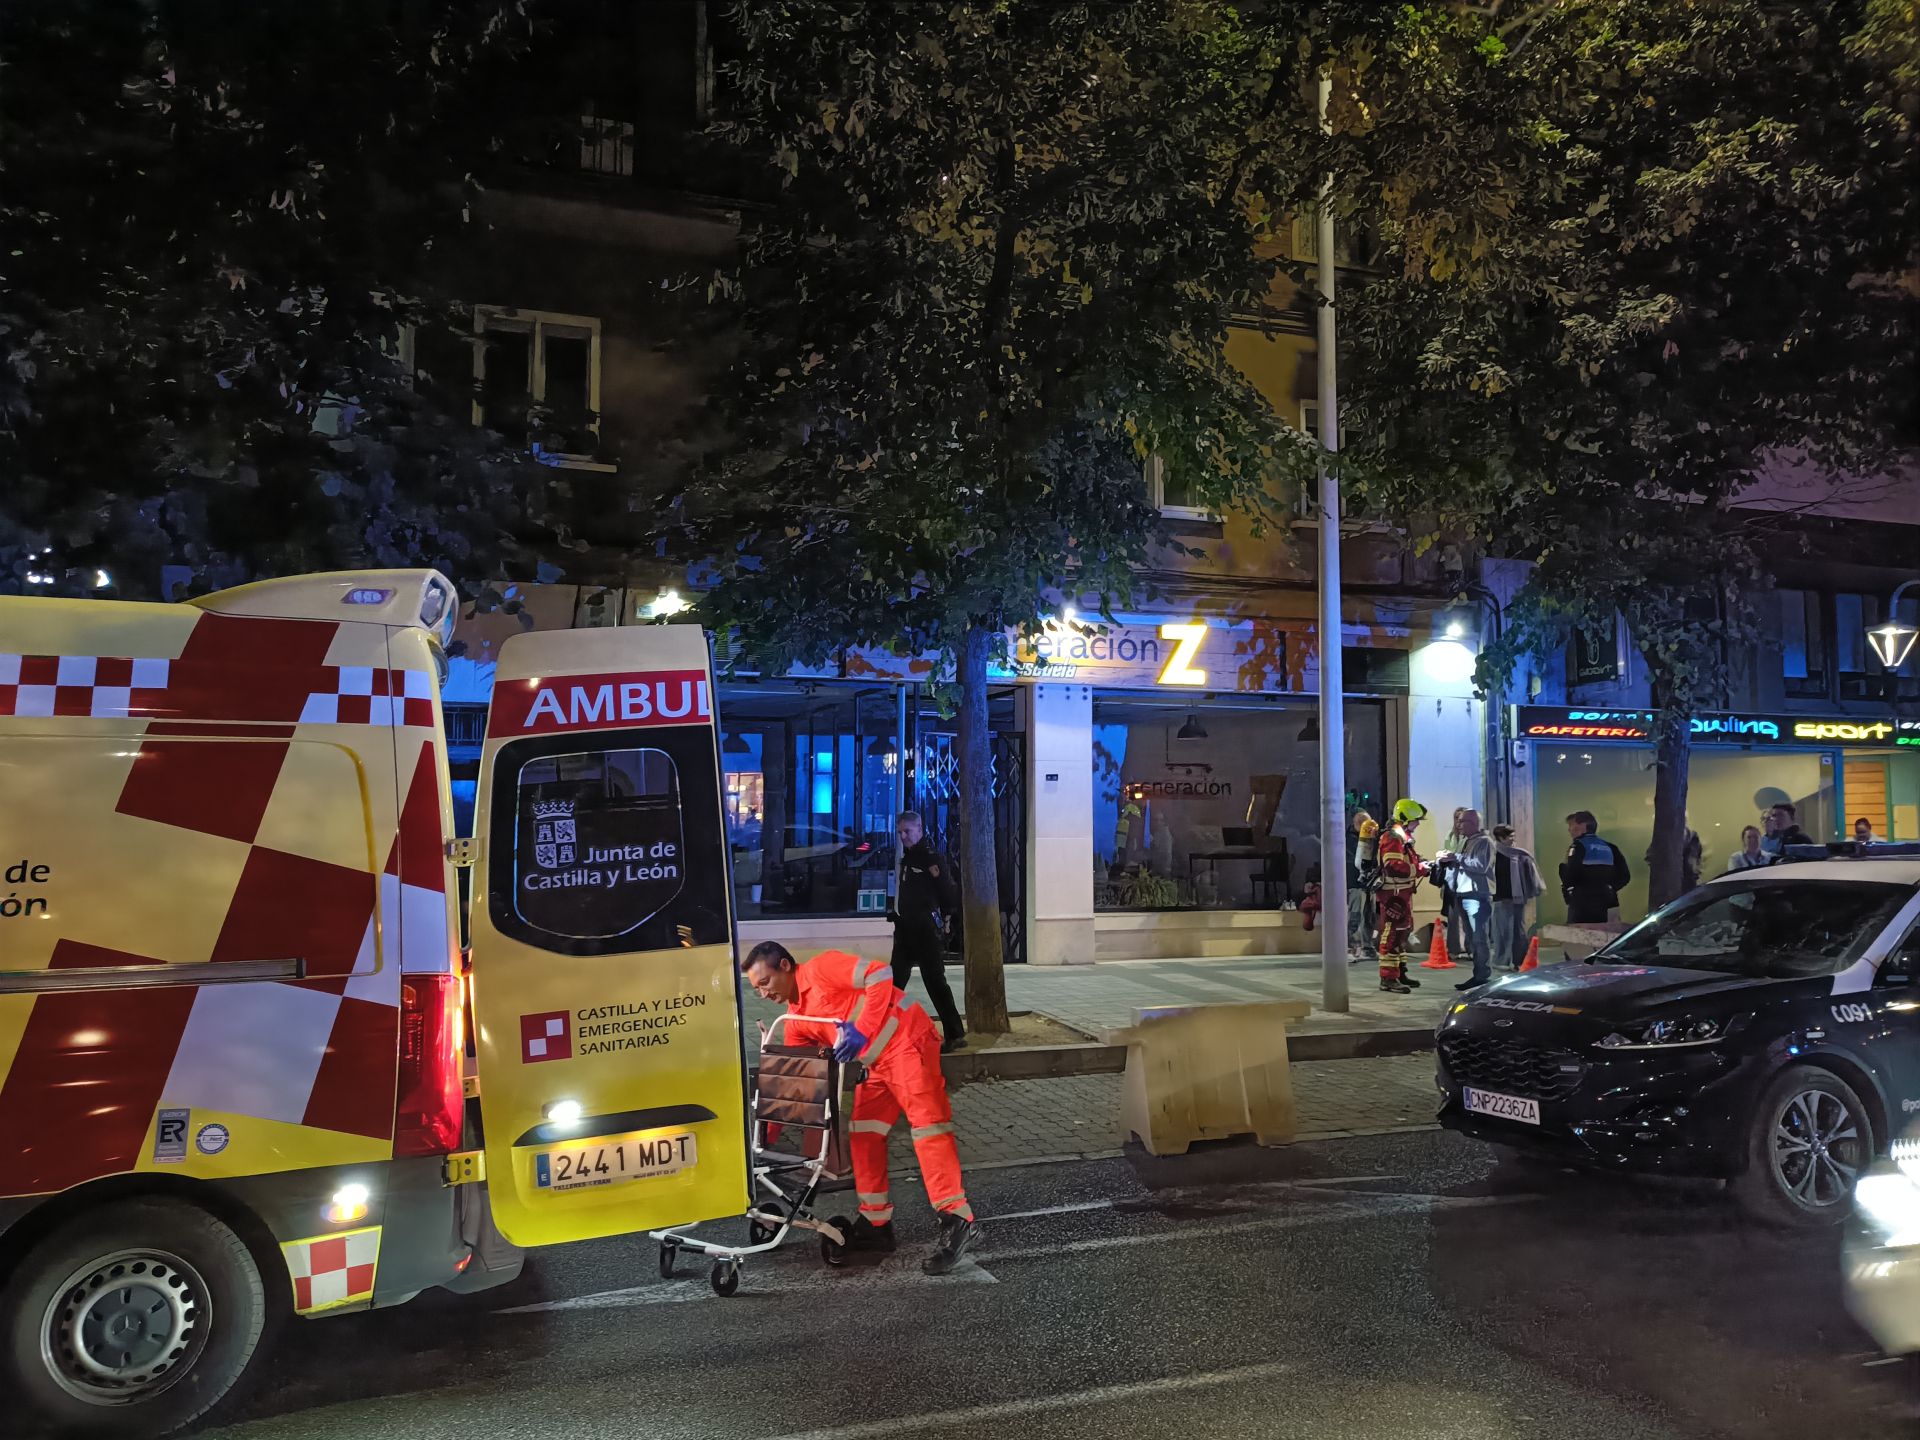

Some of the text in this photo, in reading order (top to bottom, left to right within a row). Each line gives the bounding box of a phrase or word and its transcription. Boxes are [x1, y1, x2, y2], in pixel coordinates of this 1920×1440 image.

[1157, 624, 1208, 685] Z
[1689, 716, 1892, 739] owling sport
[584, 842, 676, 864] Junta de
[5, 859, 50, 884] de
[524, 863, 677, 890] Castilla y León
[577, 993, 706, 1021] CASTILLA Y LEÓN
[579, 1013, 687, 1038] EMERGENCIAS
[580, 1033, 670, 1056] SANITARIAS
[1470, 1091, 1537, 1121] CNP2236ZA
[557, 1136, 690, 1182] 2441 MDT
